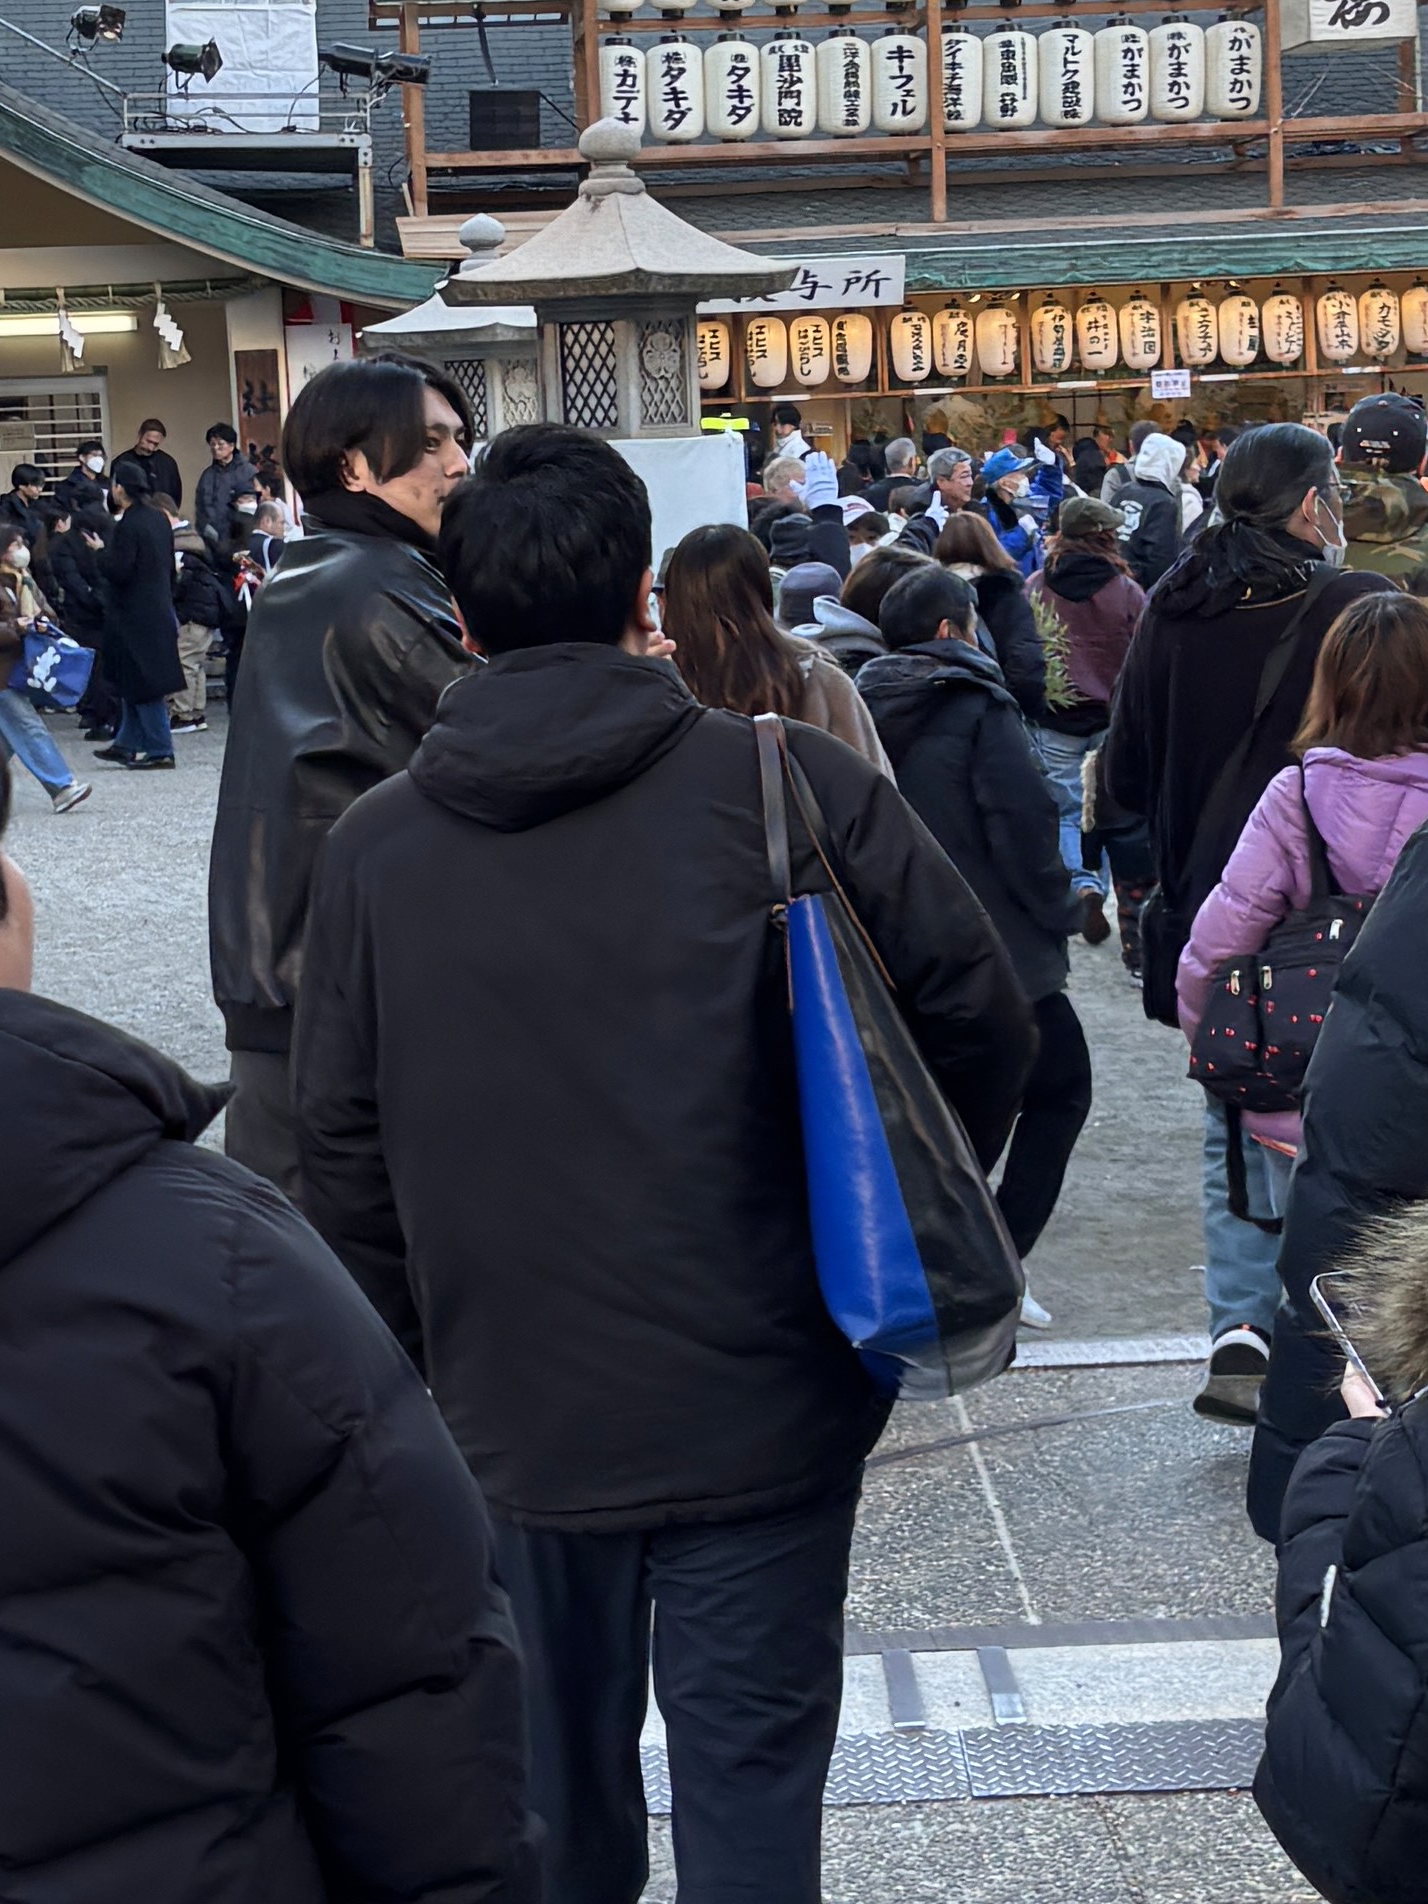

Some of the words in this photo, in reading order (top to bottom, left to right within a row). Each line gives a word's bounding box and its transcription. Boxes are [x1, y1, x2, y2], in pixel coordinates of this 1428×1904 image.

[885, 45, 917, 118] キーフェル
